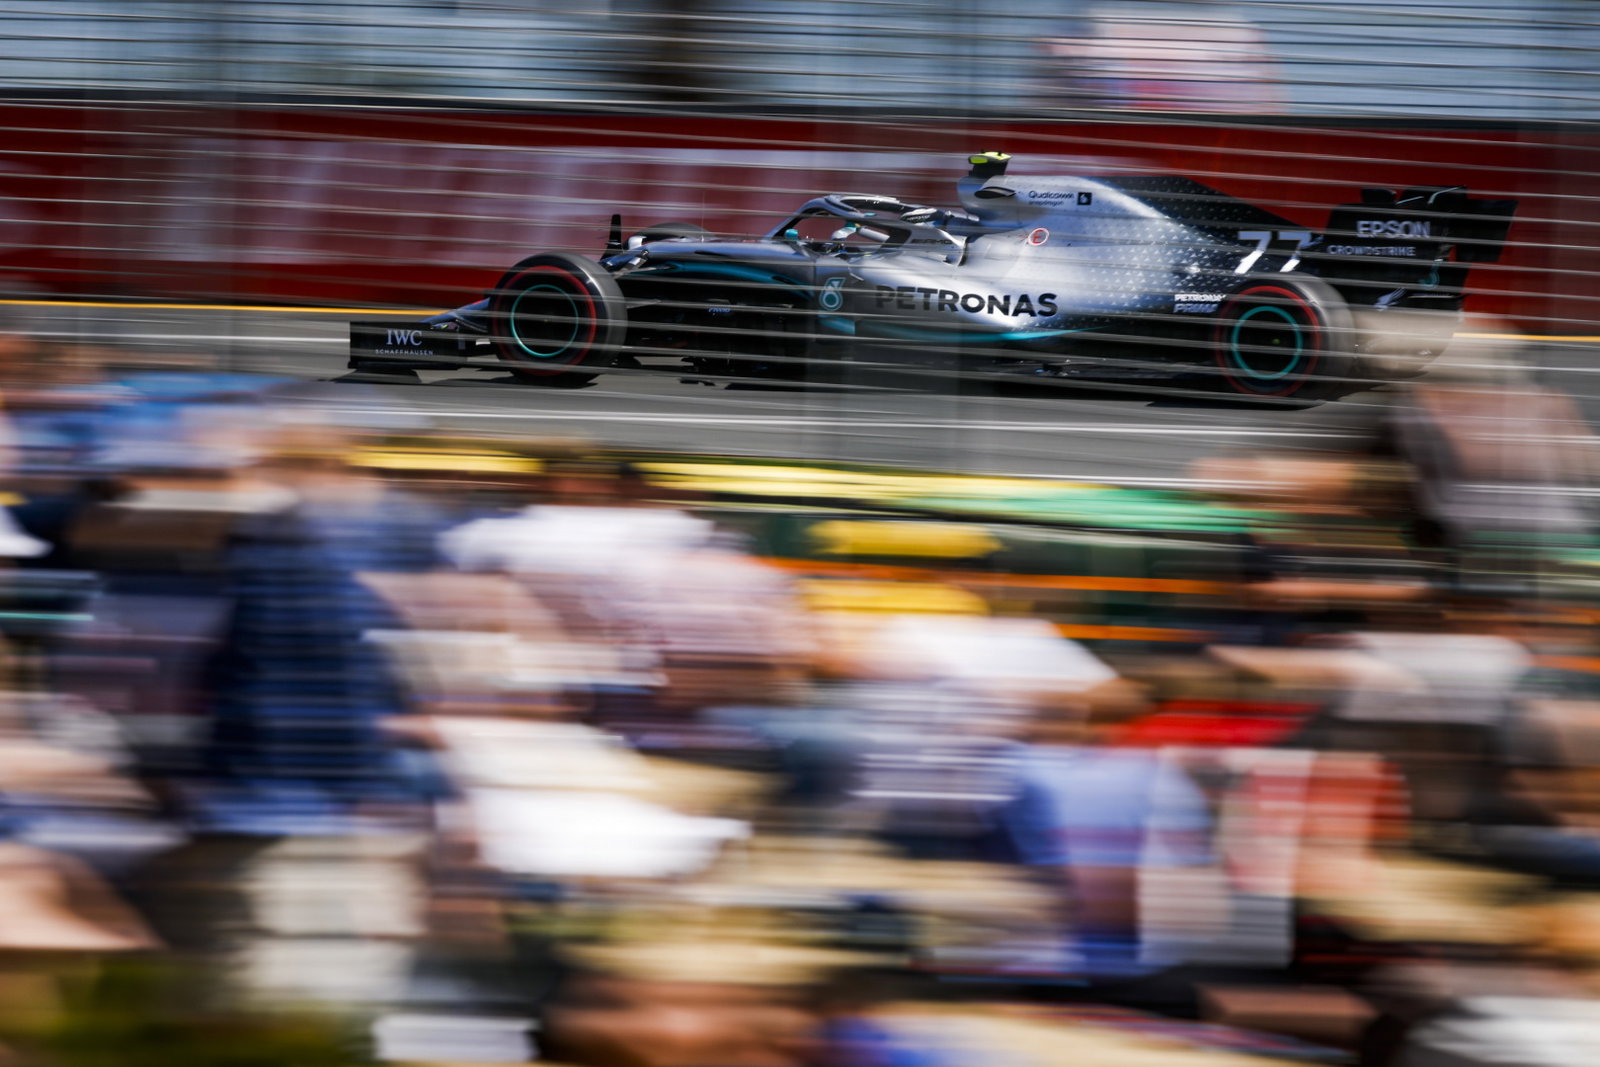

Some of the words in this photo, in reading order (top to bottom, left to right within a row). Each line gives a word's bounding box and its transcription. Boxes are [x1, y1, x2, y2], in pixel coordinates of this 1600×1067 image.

[1356, 220, 1431, 238] EPSON
[1233, 231, 1312, 275] 77
[1327, 244, 1417, 256] CROWDSTRIKE
[874, 284, 1059, 317] PETRONAS
[385, 329, 423, 346] IWC
